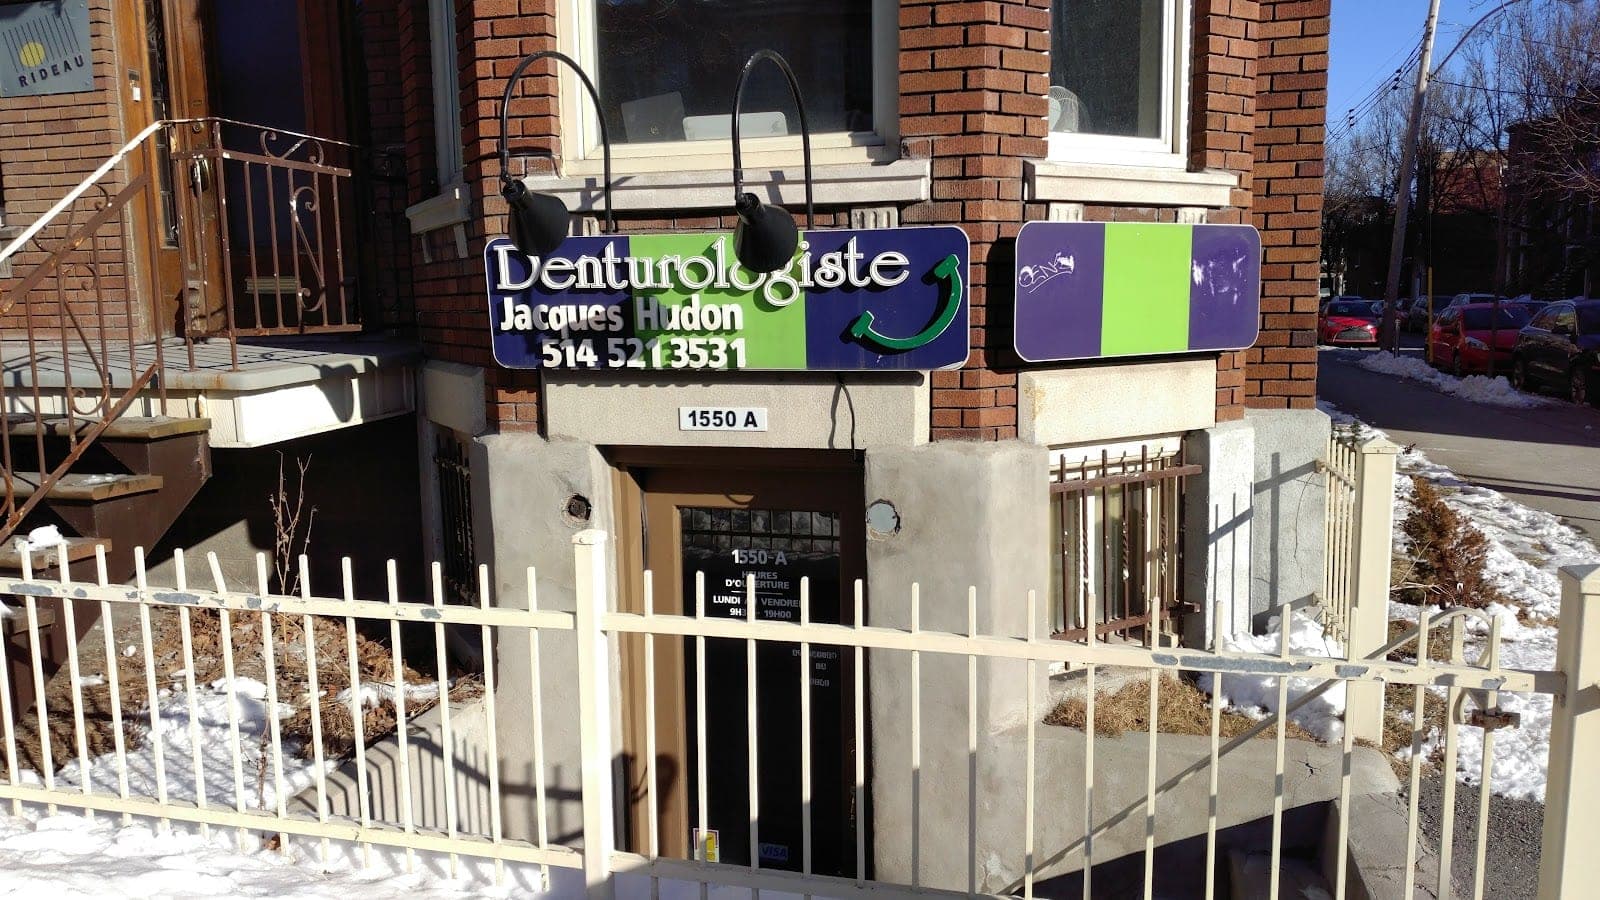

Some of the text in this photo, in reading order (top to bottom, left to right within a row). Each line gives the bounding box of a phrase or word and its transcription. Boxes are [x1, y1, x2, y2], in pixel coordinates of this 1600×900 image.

[19, 55, 84, 87] RIDEAU
[500, 293, 744, 340] Jacques Hudon
[541, 337, 747, 369] 514 521 3531
[688, 410, 758, 428] 1550 A
[731, 549, 788, 566] 1550-A
[725, 578, 790, 590] D'OUERTURE
[713, 595, 741, 605] LUNDI
[761, 597, 804, 608] VENDRE
[760, 845, 787, 858] VISA
